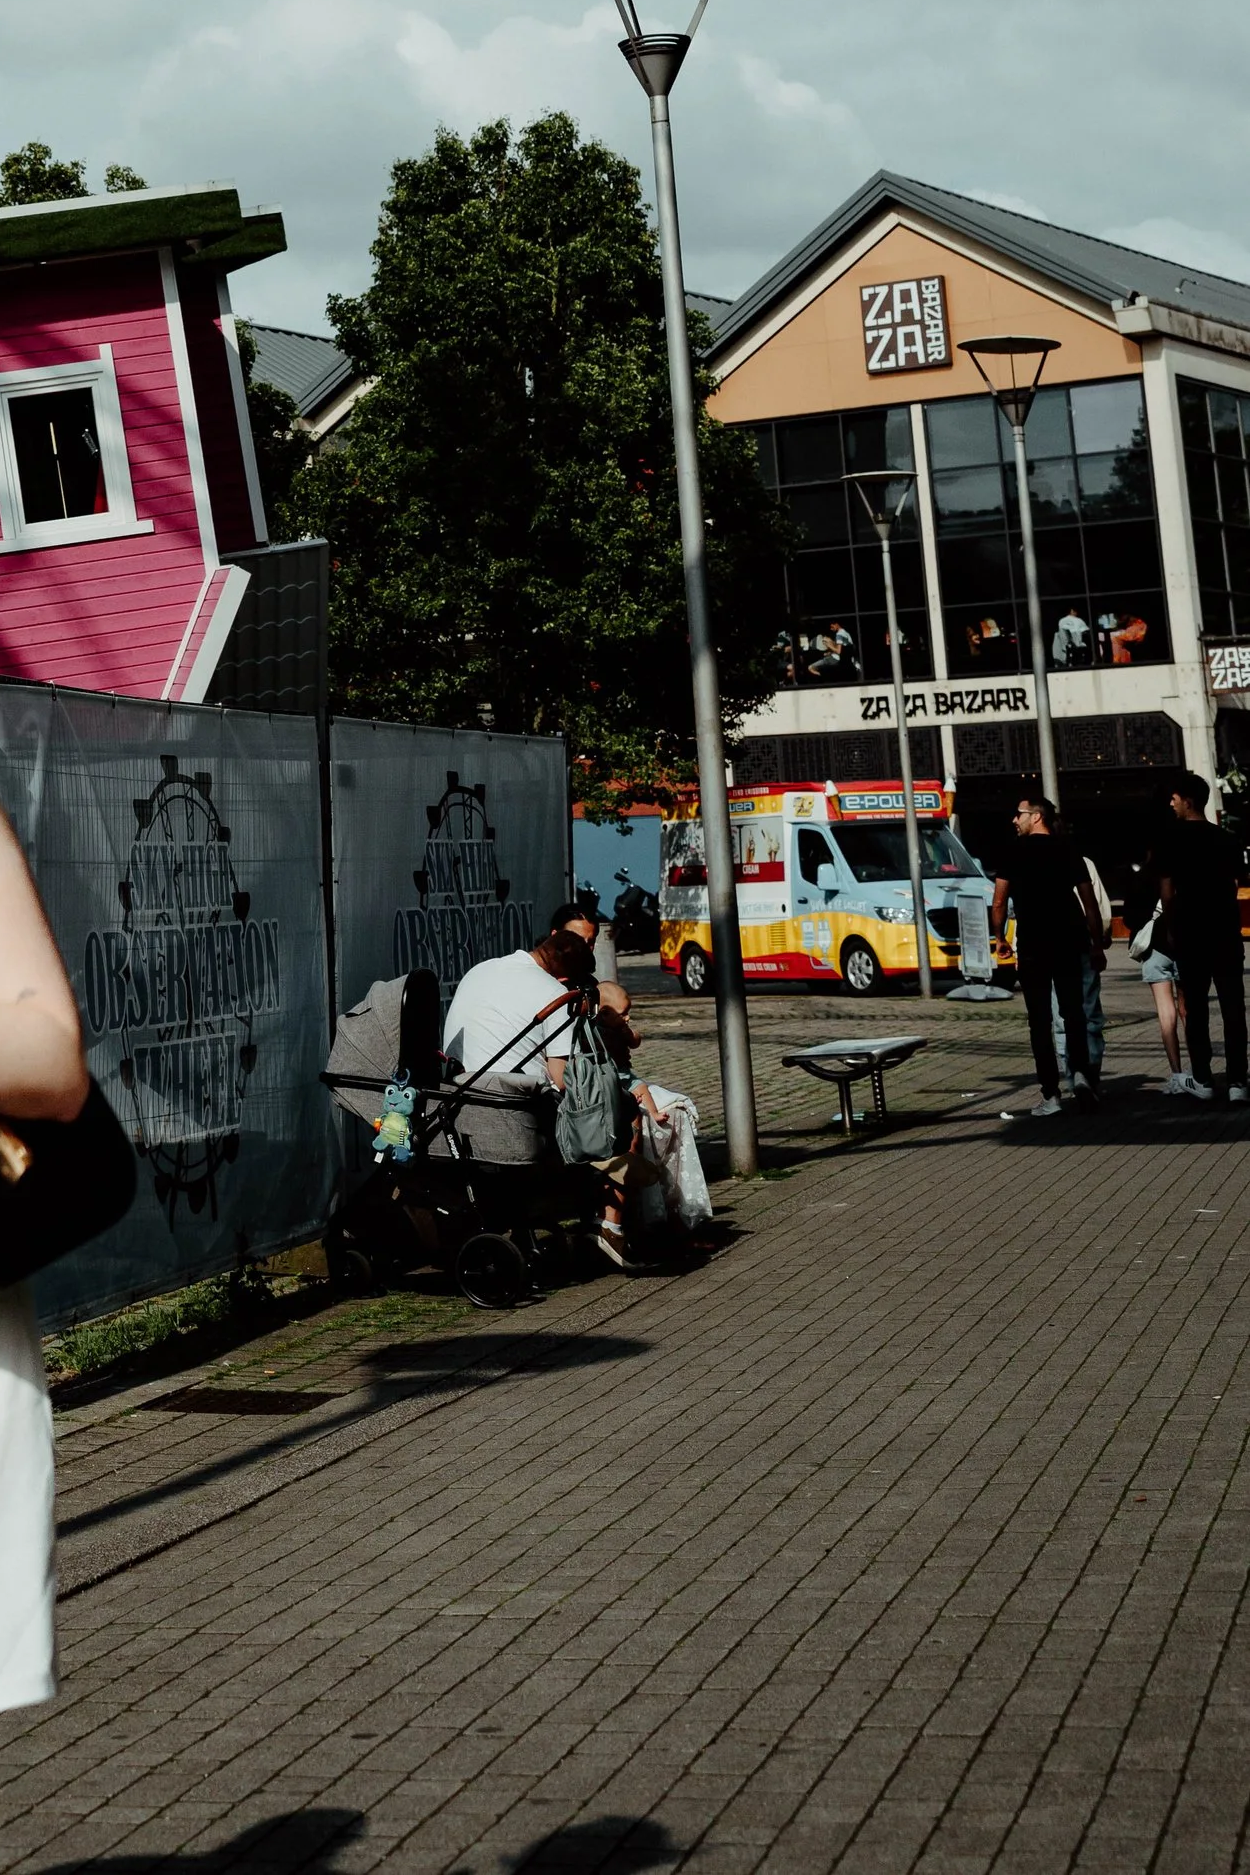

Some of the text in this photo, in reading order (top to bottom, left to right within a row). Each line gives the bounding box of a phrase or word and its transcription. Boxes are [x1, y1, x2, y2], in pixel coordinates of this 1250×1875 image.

[861, 281, 922, 327] ZA
[921, 278, 946, 363] BAZAAR
[865, 324, 926, 371] ZA
[1208, 647, 1240, 669] ZA
[1211, 668, 1243, 689] ZA
[860, 696, 891, 720] ZA
[933, 687, 1030, 716] BAZAAR
[180, 840, 234, 911] HIGH
[83, 918, 282, 1036] OBSERVATION
[131, 1031, 243, 1148] WHEEL
